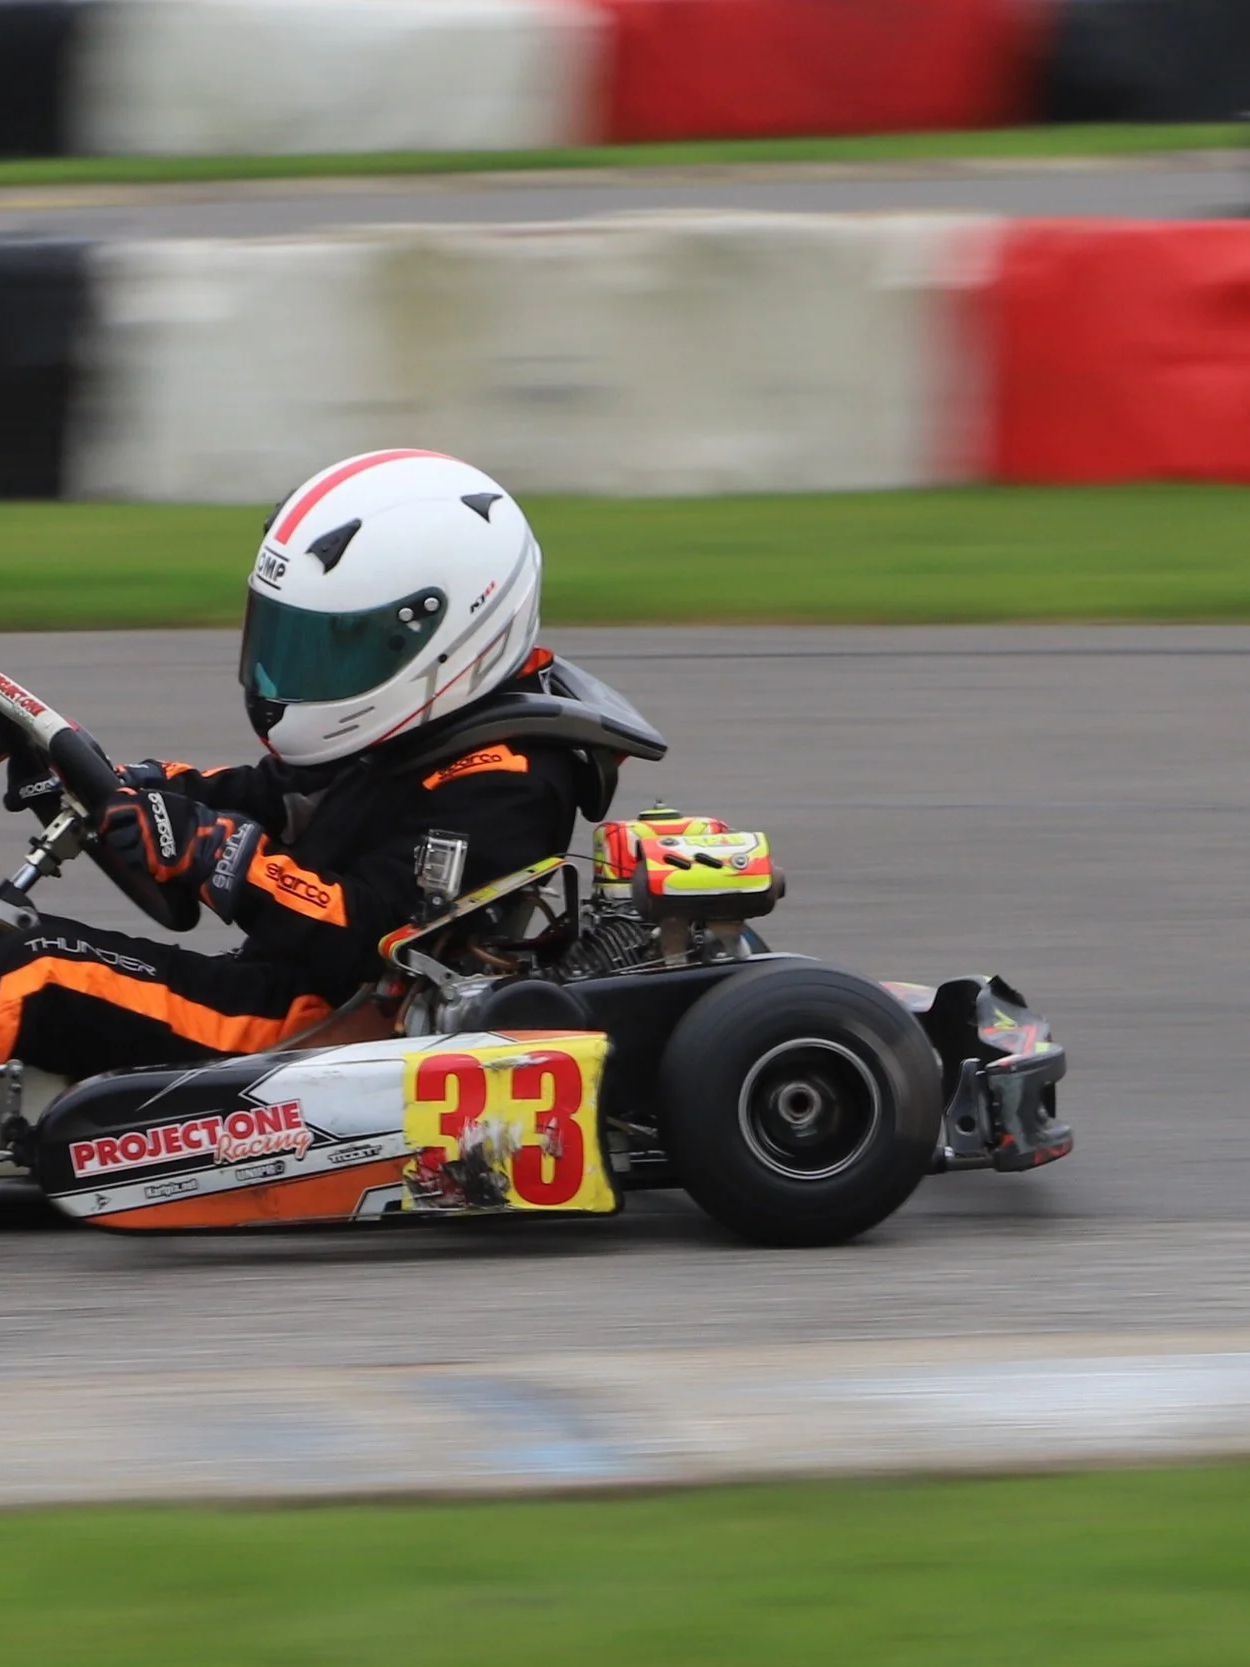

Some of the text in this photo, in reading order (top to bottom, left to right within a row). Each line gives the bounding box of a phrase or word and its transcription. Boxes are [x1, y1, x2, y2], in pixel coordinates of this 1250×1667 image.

[257, 550, 286, 582] OMP
[147, 791, 177, 859] sparco
[24, 936, 157, 977] THUNDER
[72, 1101, 303, 1171] PROJECT ONE
[213, 1129, 314, 1162] Racing
[415, 1049, 585, 1207] 33
